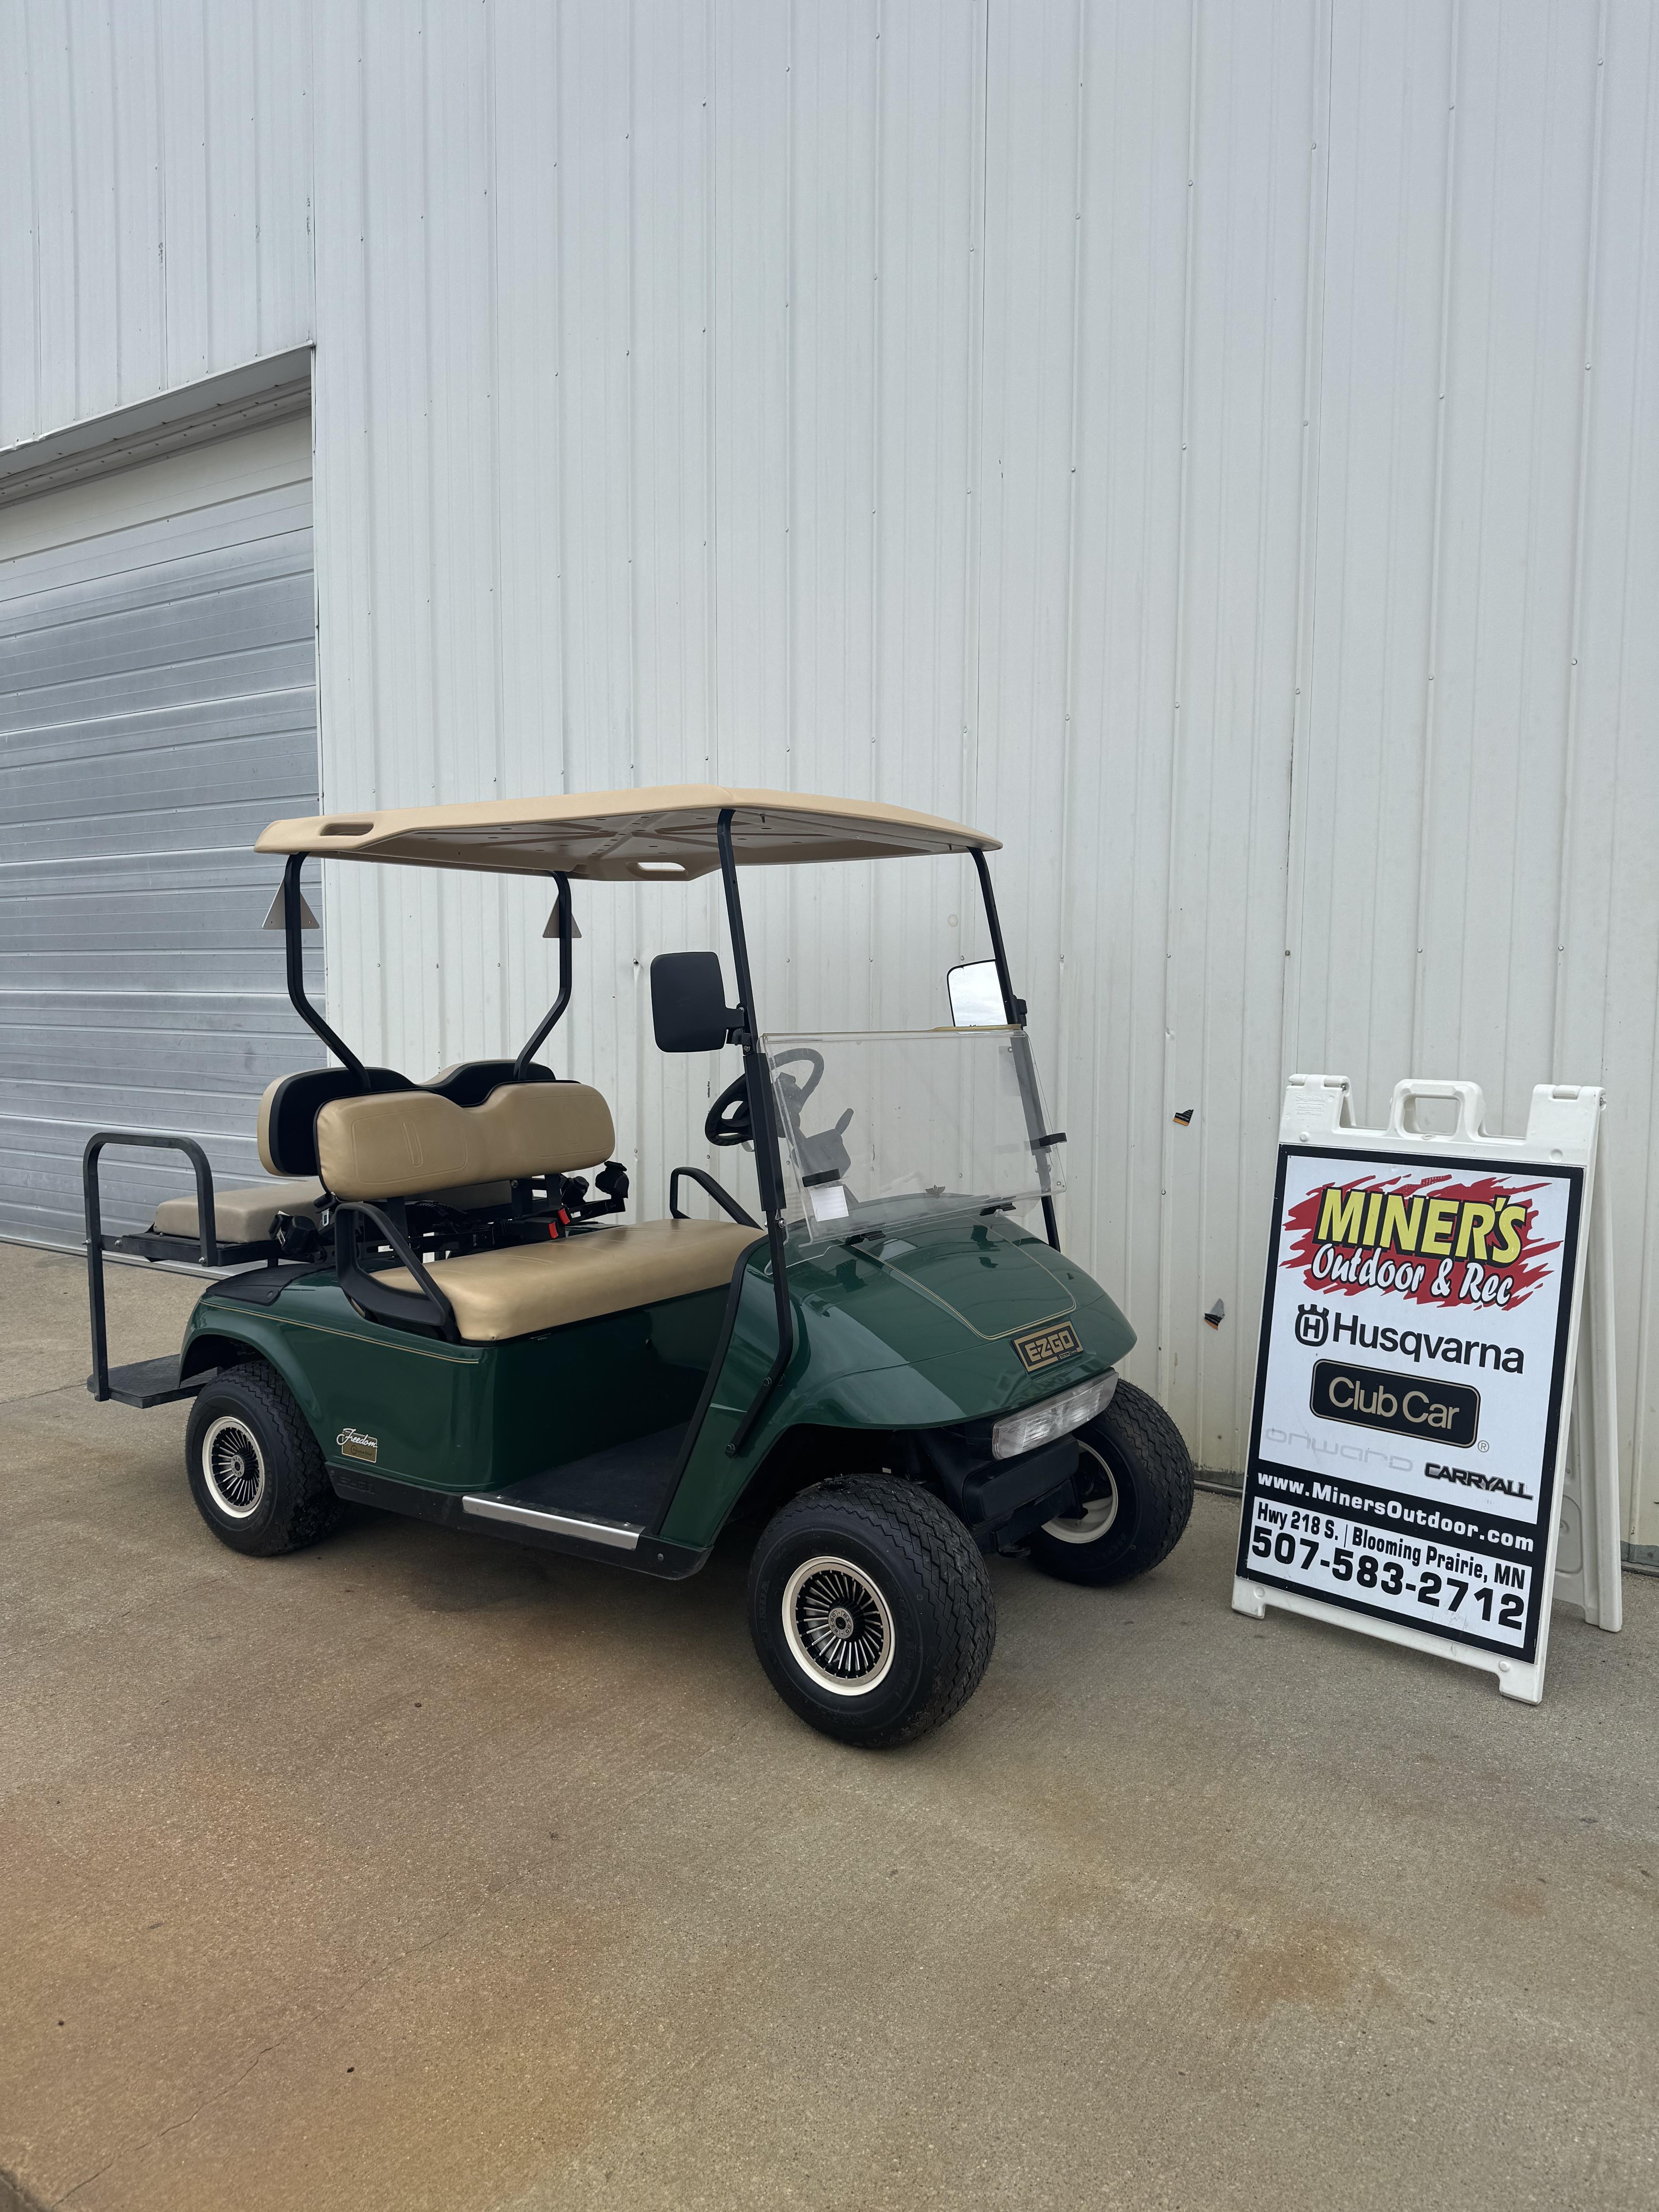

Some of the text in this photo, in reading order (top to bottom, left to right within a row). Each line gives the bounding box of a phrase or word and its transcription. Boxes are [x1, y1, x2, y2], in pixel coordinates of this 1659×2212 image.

[1315, 1187, 1527, 1265] MINER'S
[1312, 1243, 1513, 1304] Outdoor & Rec
[1333, 1312, 1524, 1374] Husqvarna
[1329, 1376, 1460, 1430] Club Car
[336, 1428, 378, 1448] Freedom
[1257, 1472, 1534, 1552] www.MinersOutdoor.com
[1424, 1462, 1534, 1501] CARRYALL
[1257, 1501, 1525, 1590] Hwy 218 S. Blooming Prairie, MN
[1252, 1525, 1525, 1631] 507-583-2712
